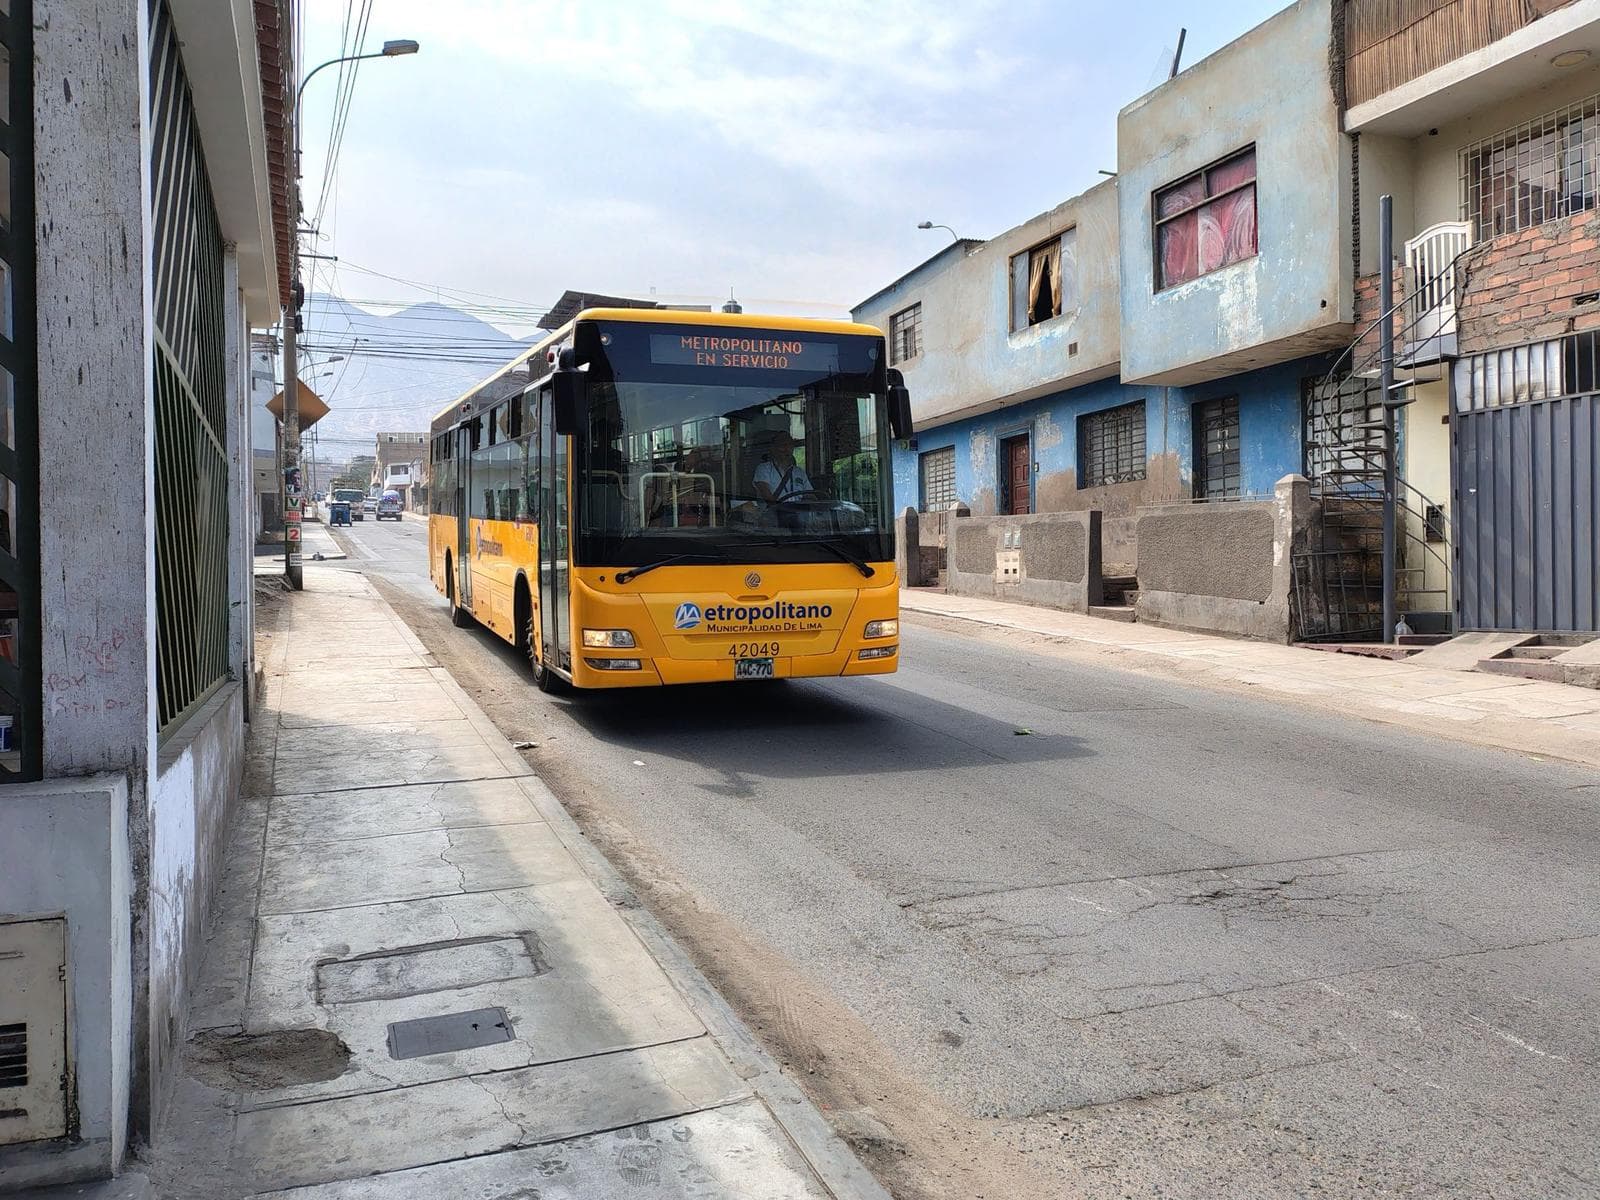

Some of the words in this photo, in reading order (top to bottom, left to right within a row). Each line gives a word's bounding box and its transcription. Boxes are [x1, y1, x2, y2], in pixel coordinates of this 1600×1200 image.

[680, 336, 803, 355] METROPOLITANO
[696, 352, 716, 366] EN
[722, 353, 789, 369] SERVICIO
[289, 528, 300, 540] 2
[728, 641, 780, 658] 42049
